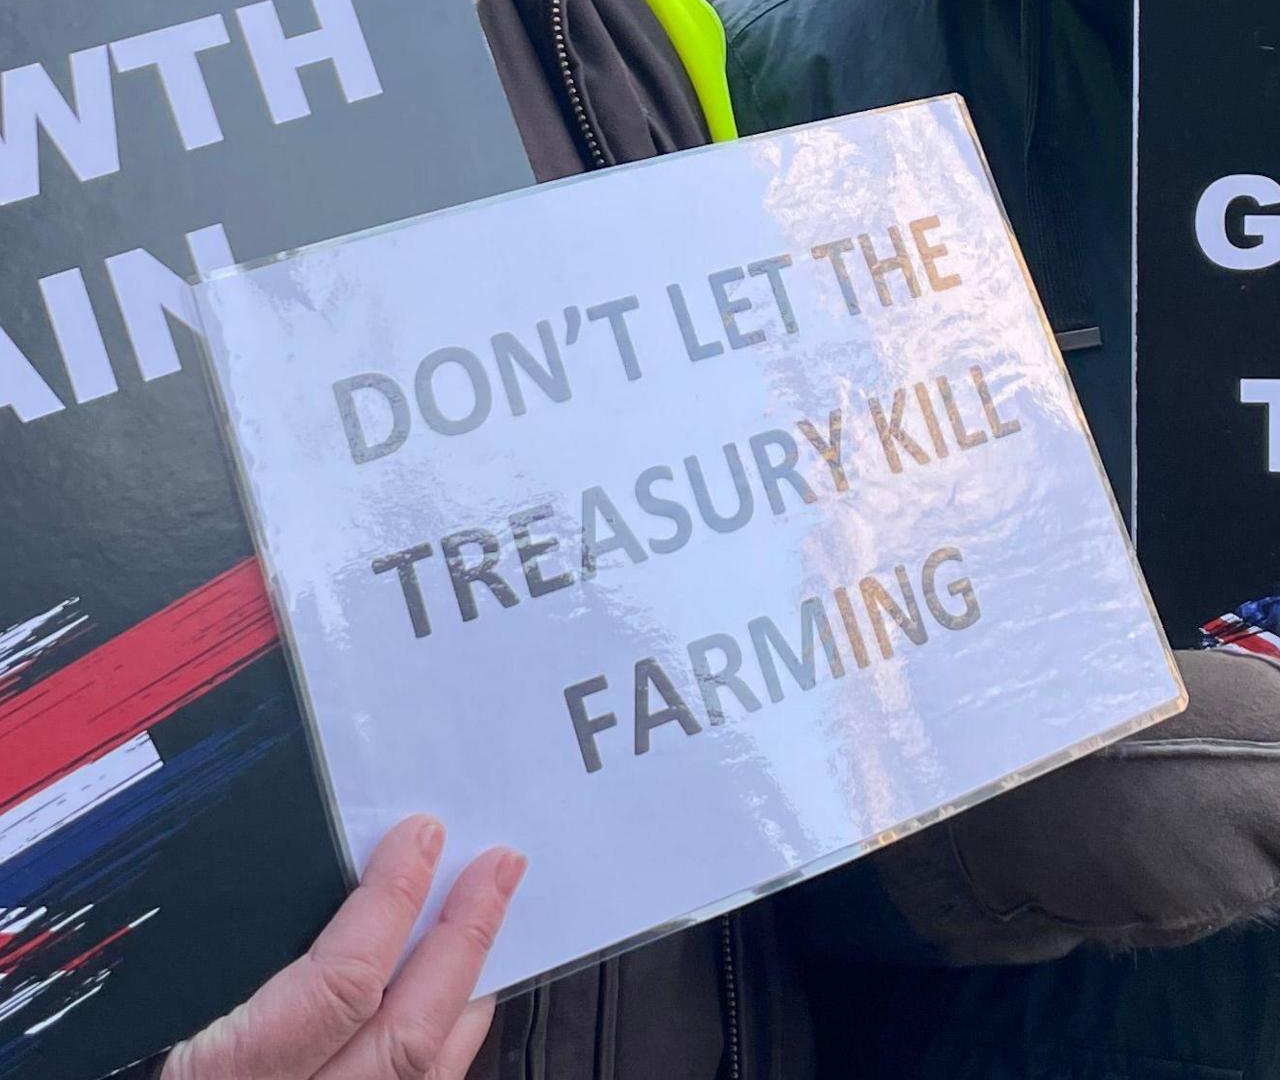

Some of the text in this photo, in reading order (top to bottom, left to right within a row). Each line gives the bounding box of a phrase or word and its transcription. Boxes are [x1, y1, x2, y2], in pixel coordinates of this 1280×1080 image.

[332, 215, 962, 465] DON’T LET THE
[371, 365, 1020, 639] TREASURY KILL
[564, 546, 982, 774] FARMING
